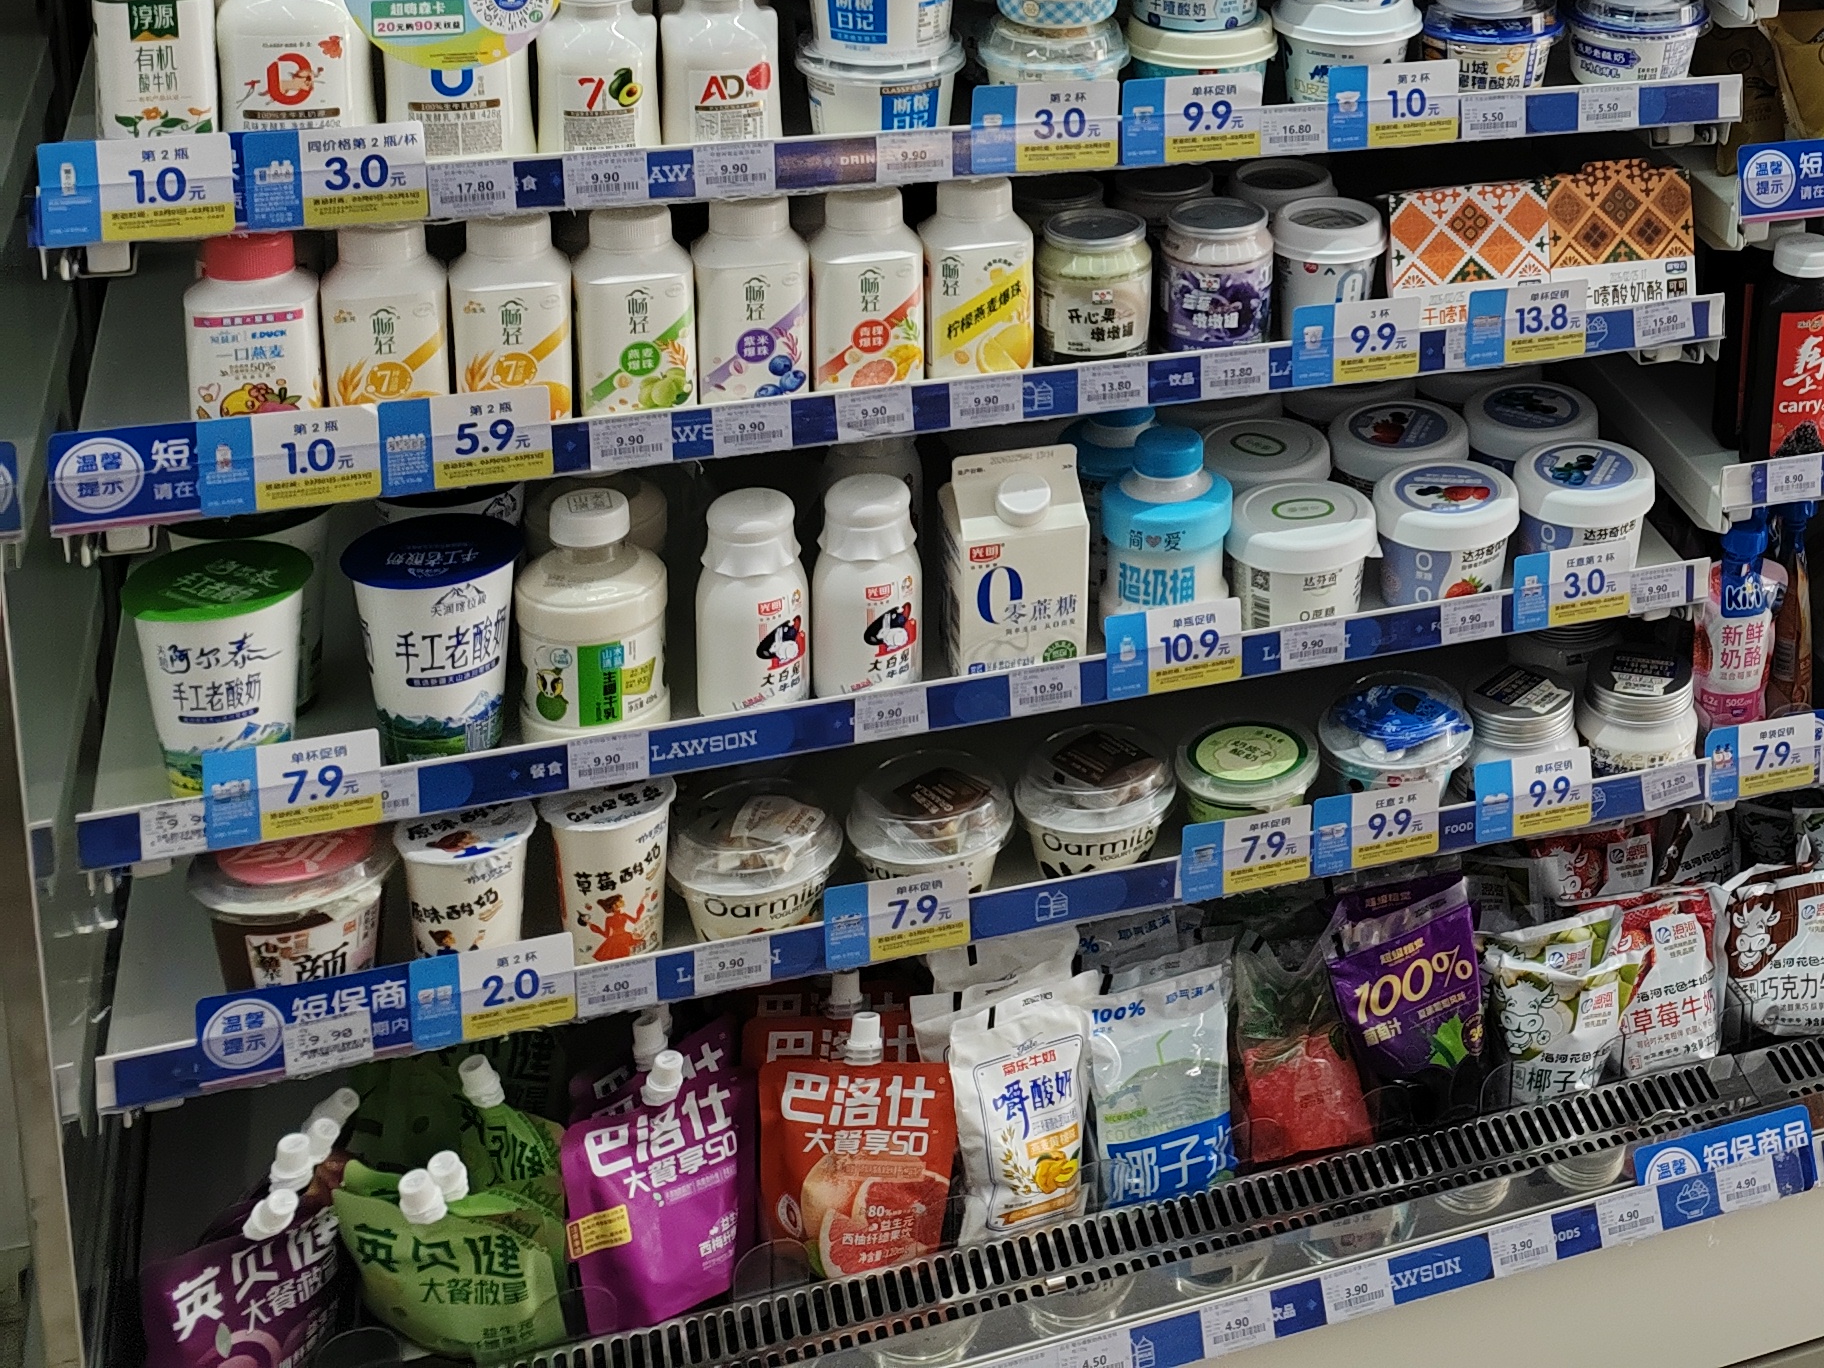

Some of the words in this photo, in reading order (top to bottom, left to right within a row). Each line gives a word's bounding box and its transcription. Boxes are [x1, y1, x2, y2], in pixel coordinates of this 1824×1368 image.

[135, 45, 177, 72] 有机
[139, 70, 178, 94] 酸牛奶
[700, 74, 744, 105] AD
[1192, 84, 1237, 97] 单杯促销
[1183, 101, 1244, 132] 9.9元
[1387, 88, 1440, 118] 1.0元
[1481, 111, 1504, 123] 5.50
[1598, 102, 1618, 113] 5.50
[128, 168, 207, 205] 1.0元
[324, 155, 407, 191] 3.0元
[1652, 315, 1679, 328] 15.80
[1350, 323, 1408, 355] 9.9元
[455, 419, 531, 456] 5.9元
[738, 421, 765, 434] 9.90
[280, 437, 354, 475] 1.0元
[1563, 571, 1616, 600] 3.0元
[1724, 575, 1763, 612] Kiri
[1004, 594, 1077, 623] 零蔗糖
[395, 607, 507, 673] 手工老酸奶
[1159, 629, 1231, 664] 10.9元
[1721, 623, 1764, 646] 新鲜
[1721, 645, 1763, 669] 奶酪
[173, 670, 262, 712] 手工老酸奶
[1032, 681, 1063, 695] 10.90
[877, 708, 902, 720] 9.90
[291, 745, 347, 764] 单杯促销
[651, 729, 757, 762] LAWSON
[283, 765, 359, 804] 7.9元
[1367, 808, 1424, 840] 9.9元
[1242, 832, 1298, 863] 7.9元
[574, 843, 661, 895] 草莓酸奶
[887, 896, 952, 929] 7.9元
[496, 951, 538, 969] 第2杯
[482, 969, 556, 1009] 2.0元
[602, 980, 630, 994] 4.00
[1354, 945, 1473, 1024] 100%
[1631, 989, 1717, 1035] 草莓牛奶
[781, 1071, 937, 1127] 巴洛仕
[584, 1082, 732, 1178] 巴洛仕
[1701, 1120, 1810, 1170] 短保商品
[1108, 1128, 1236, 1202] 椰子水
[1735, 1176, 1757, 1190] 4.90
[1618, 1209, 1641, 1224] 4.90
[1510, 1238, 1534, 1253] 3.90
[1344, 1283, 1369, 1297] 3.90
